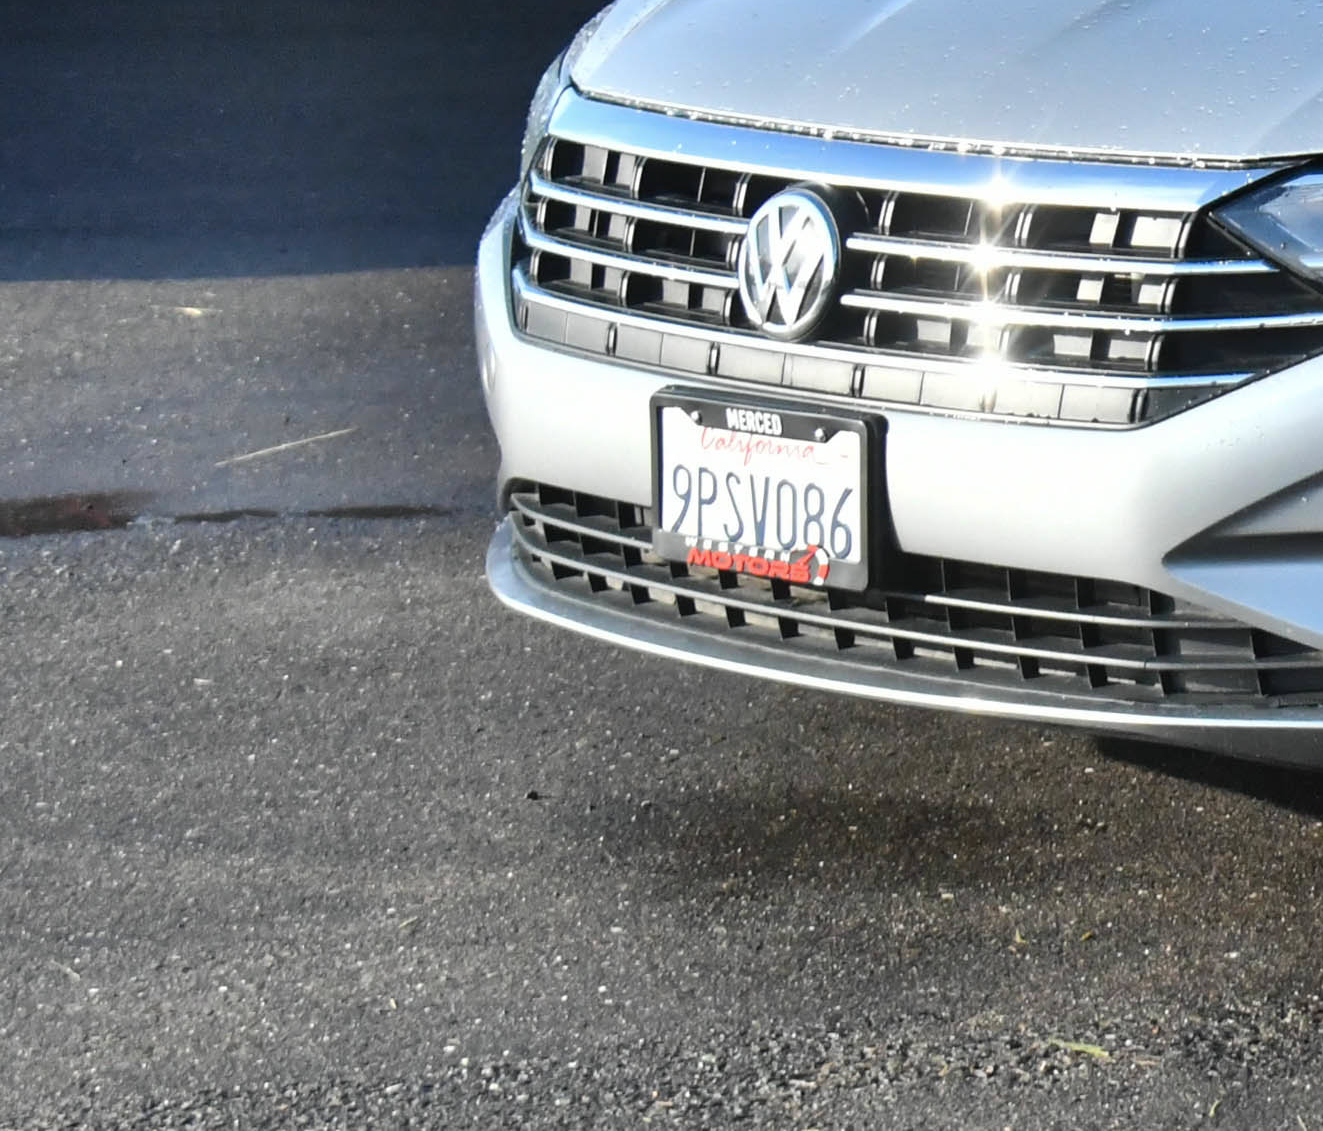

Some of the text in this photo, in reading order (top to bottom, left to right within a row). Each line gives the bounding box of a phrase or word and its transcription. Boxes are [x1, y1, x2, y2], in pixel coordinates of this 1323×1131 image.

[726, 407, 782, 436] MERCED
[700, 427, 815, 466] California
[671, 464, 853, 559] 9PSV086
[686, 547, 811, 584] MOTORS
